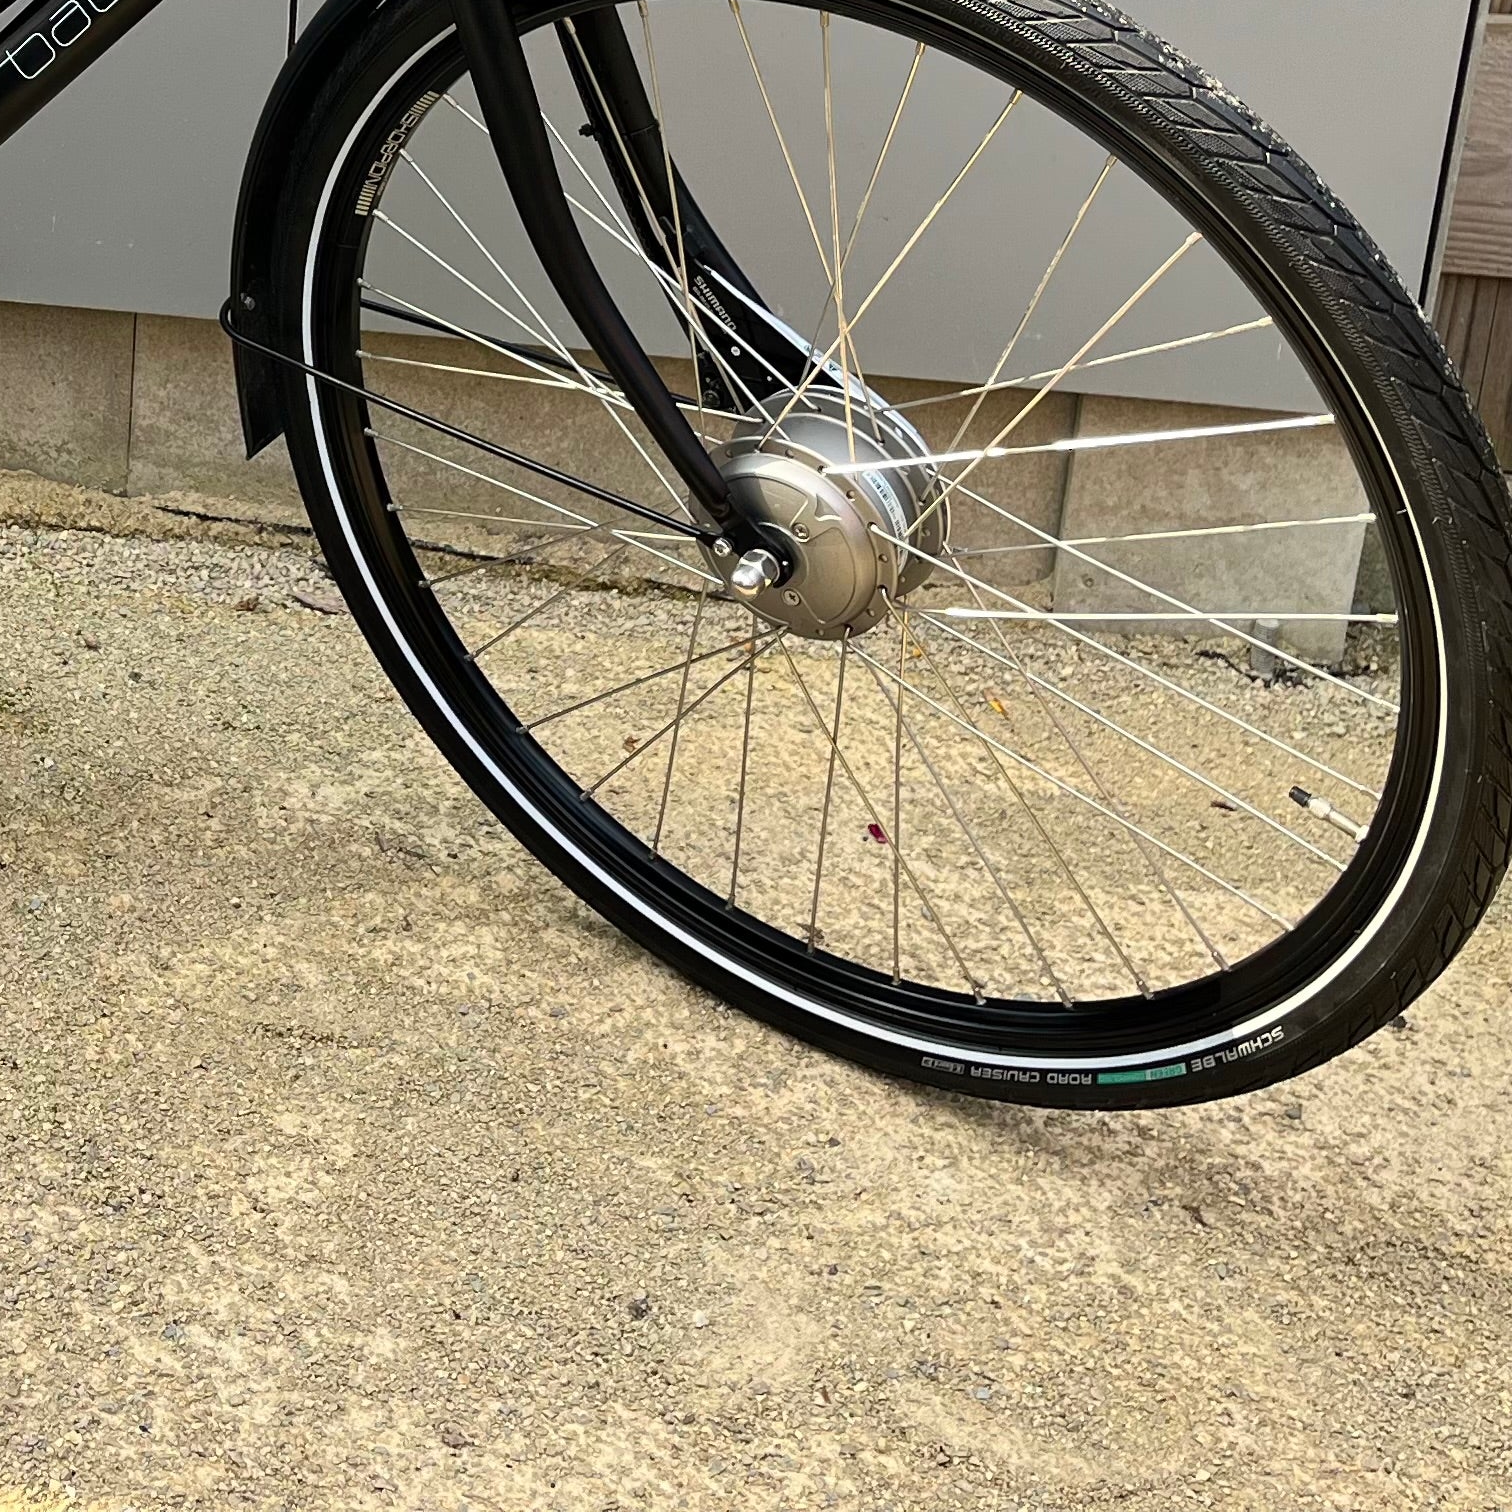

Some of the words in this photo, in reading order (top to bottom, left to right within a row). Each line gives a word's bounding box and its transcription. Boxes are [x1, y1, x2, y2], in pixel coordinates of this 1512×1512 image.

[693, 274, 737, 331] SHIMANO
[1190, 1024, 1286, 1073] SCHWALBE
[969, 1064, 1041, 1084] CRUISER
[1046, 1072, 1093, 1086] ROAD
